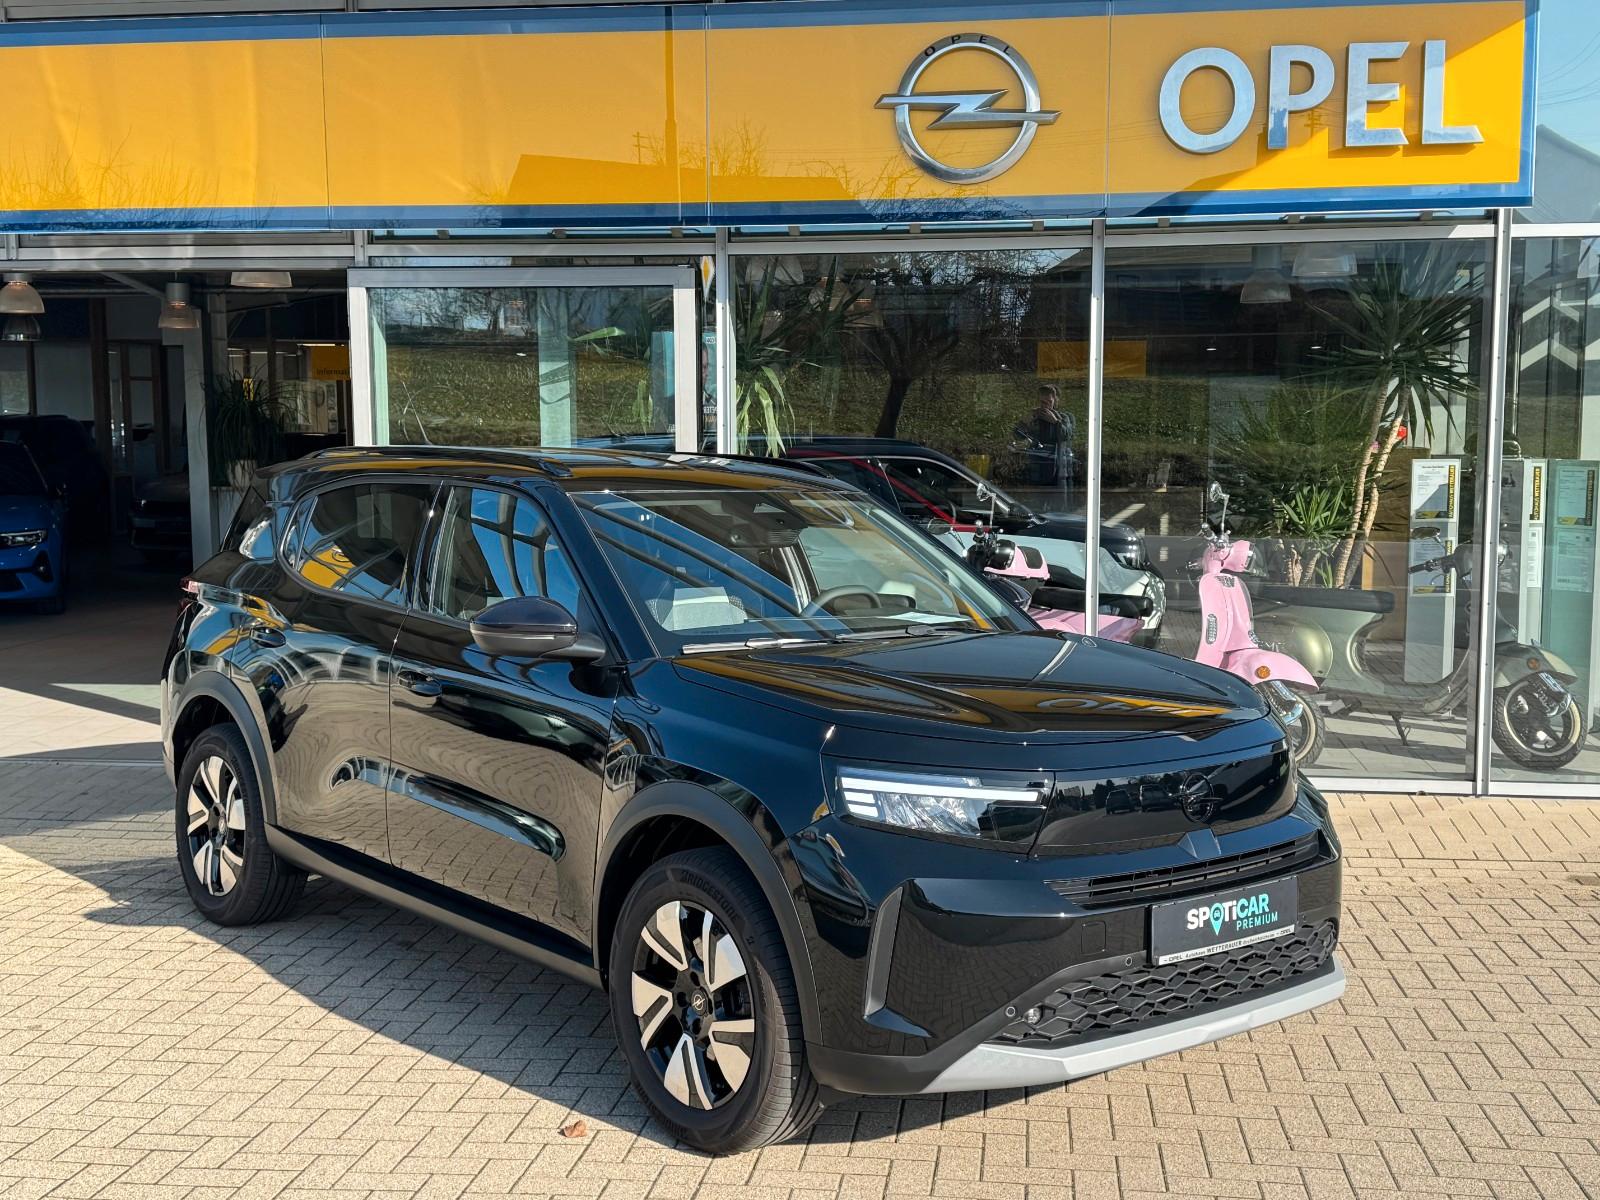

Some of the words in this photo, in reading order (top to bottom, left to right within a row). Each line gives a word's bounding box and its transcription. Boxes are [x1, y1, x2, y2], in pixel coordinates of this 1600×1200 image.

[924, 34, 1012, 57] OPEL
[1158, 39, 1485, 153] OPEL
[1236, 911, 1278, 931] PREMIUM
[1168, 954, 1183, 962] OPEL
[1206, 940, 1242, 953] WETTERAUER
